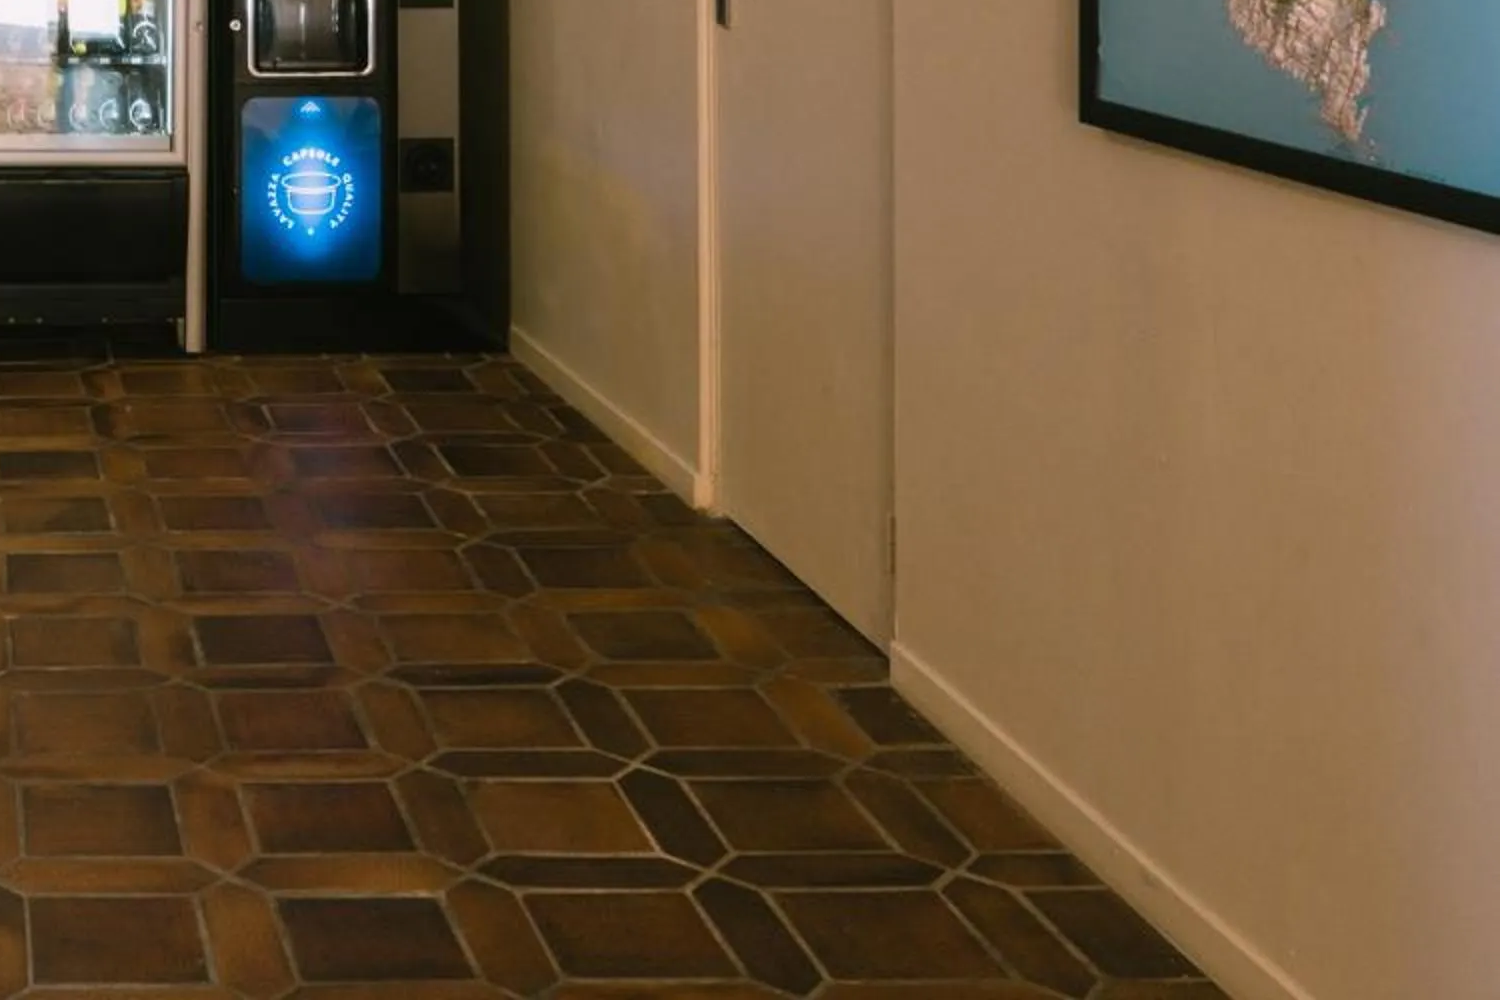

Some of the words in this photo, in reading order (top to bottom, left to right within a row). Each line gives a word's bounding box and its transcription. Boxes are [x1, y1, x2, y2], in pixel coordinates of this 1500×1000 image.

[283, 147, 340, 167] CAPSULE
[267, 173, 295, 229] LAVAZZA
[329, 173, 354, 229] QUALITY
